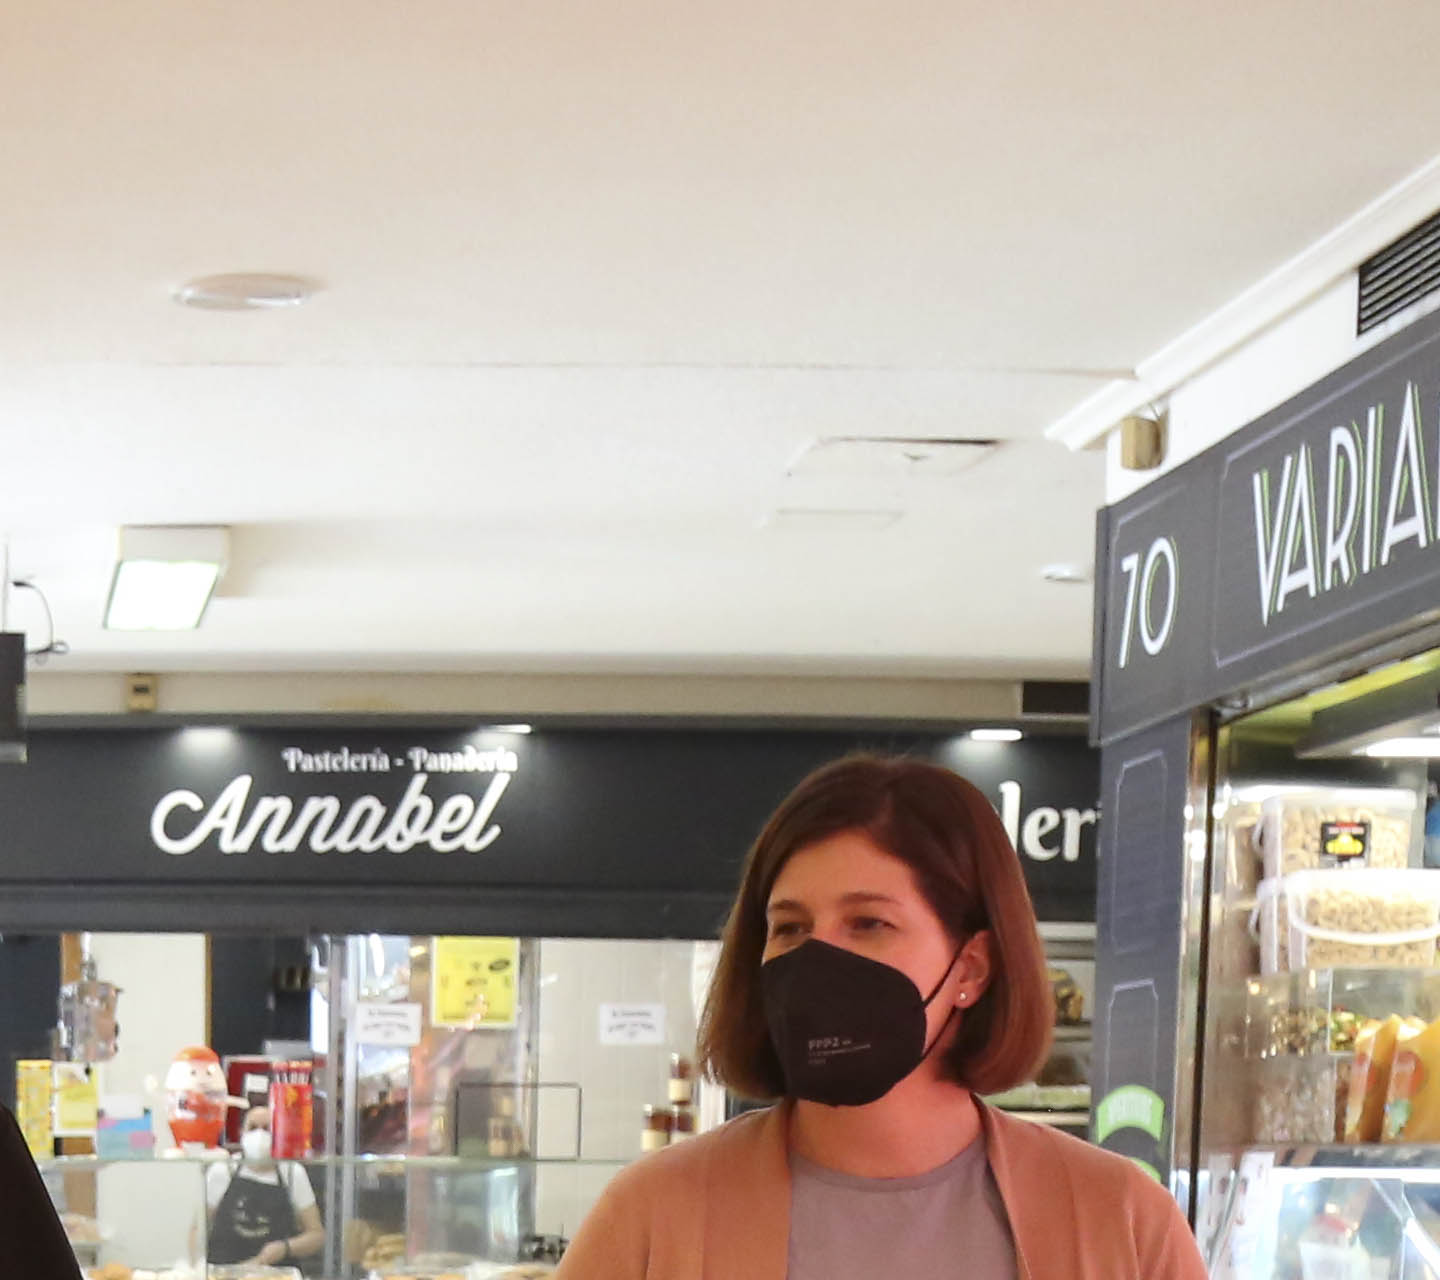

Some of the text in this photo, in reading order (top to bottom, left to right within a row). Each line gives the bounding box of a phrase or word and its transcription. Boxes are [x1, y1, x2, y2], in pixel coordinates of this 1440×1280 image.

[1122, 536, 1178, 669] 70
[281, 746, 390, 773] Pastelería
[150, 772, 511, 856] Annabel
